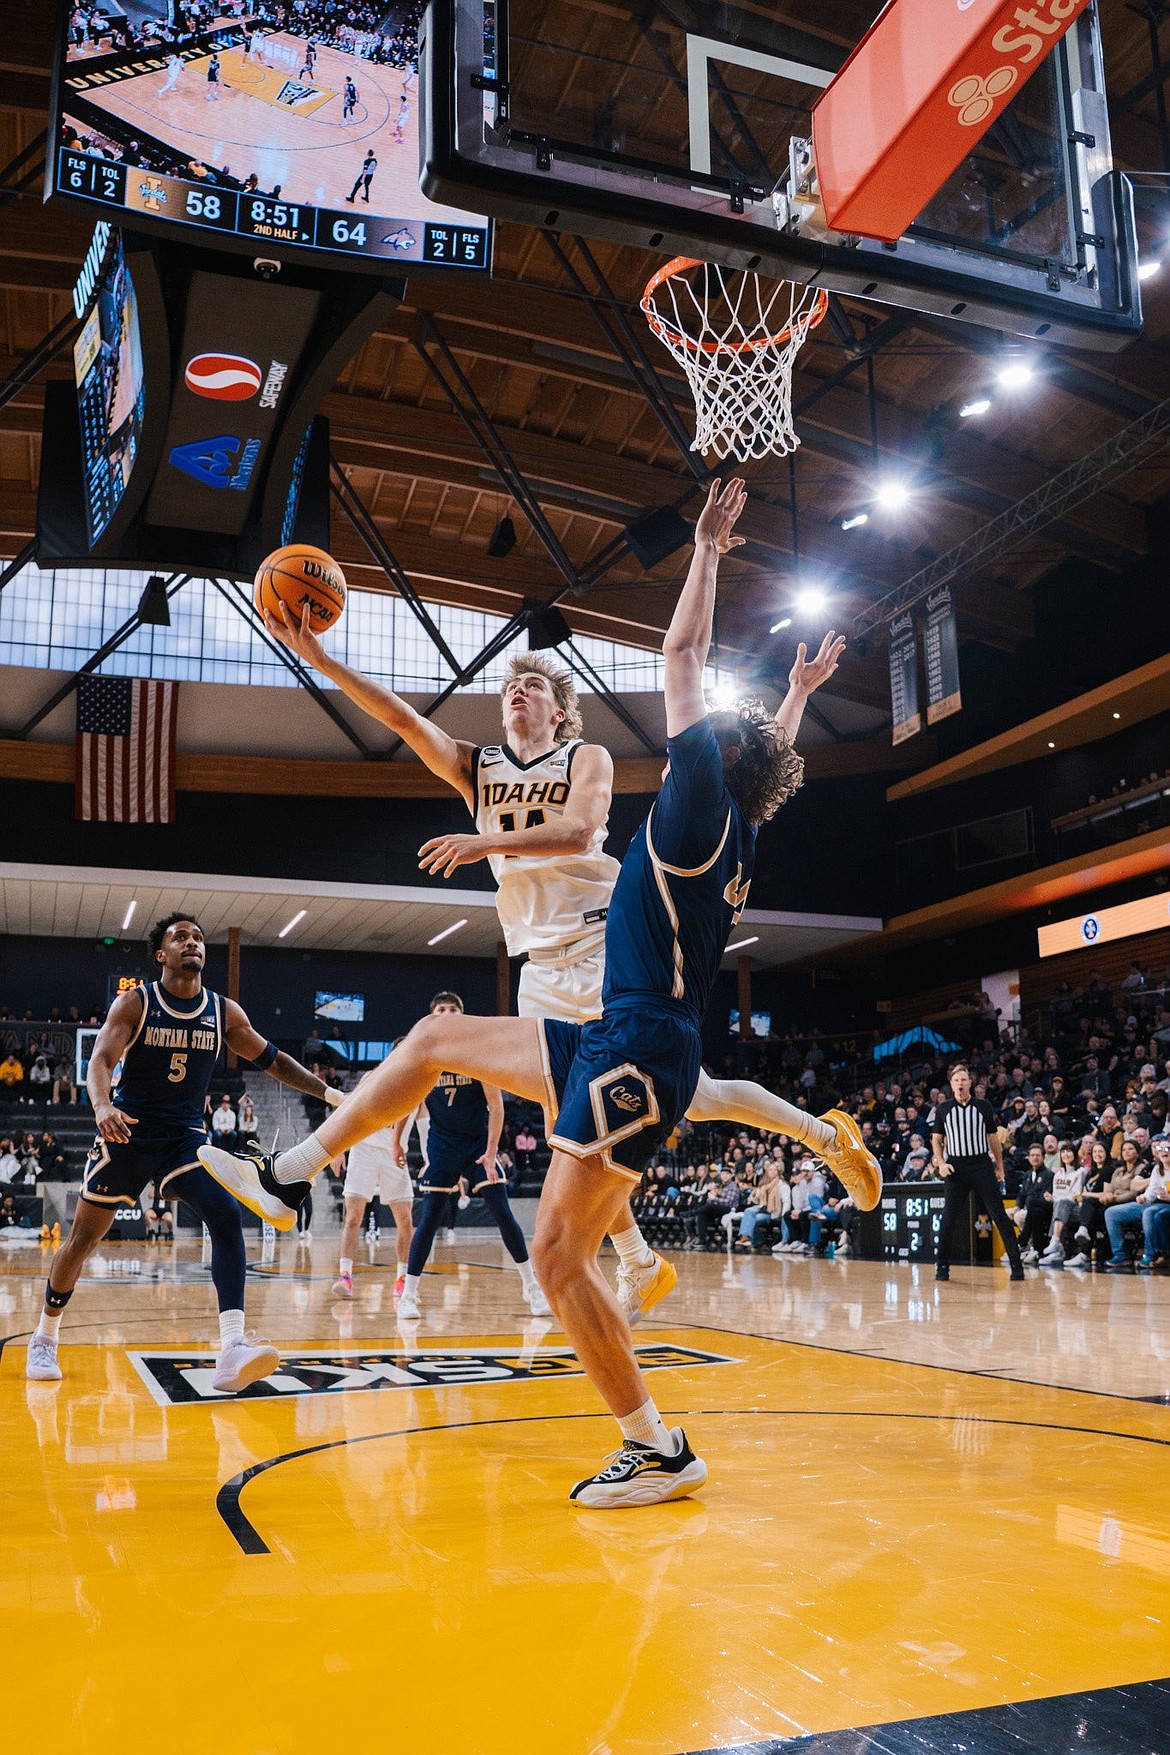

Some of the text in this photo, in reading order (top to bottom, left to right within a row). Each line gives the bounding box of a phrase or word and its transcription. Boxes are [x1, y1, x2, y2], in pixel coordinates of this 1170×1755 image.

[68, 157, 87, 171] FLS
[101, 166, 120, 181] TOL
[70, 173, 82, 188] 6
[103, 180, 116, 197] 2
[186, 190, 221, 219] 58
[250, 201, 300, 228] 8:51
[253, 224, 298, 241] 2ND HALF
[332, 219, 366, 246] 64
[430, 229, 448, 241] TOL
[462, 233, 480, 244] FLS
[433, 242, 444, 257] 2
[465, 246, 475, 260] 5
[259, 360, 288, 408] SAFEWAY
[303, 560, 346, 600] Wilson
[298, 594, 334, 623] NCAA
[483, 782, 571, 807] IDAHO
[144, 1027, 215, 1051] MONTANA STATE
[167, 1053, 188, 1083] 5
[444, 1088, 457, 1107] 7
[609, 1085, 641, 1112] Cats
[906, 1198, 928, 1217] 8:51
[883, 1212, 897, 1232] 58
[932, 1213, 943, 1232] 6
[911, 1232, 919, 1252] 2
[495, 1351, 709, 1375] BG
